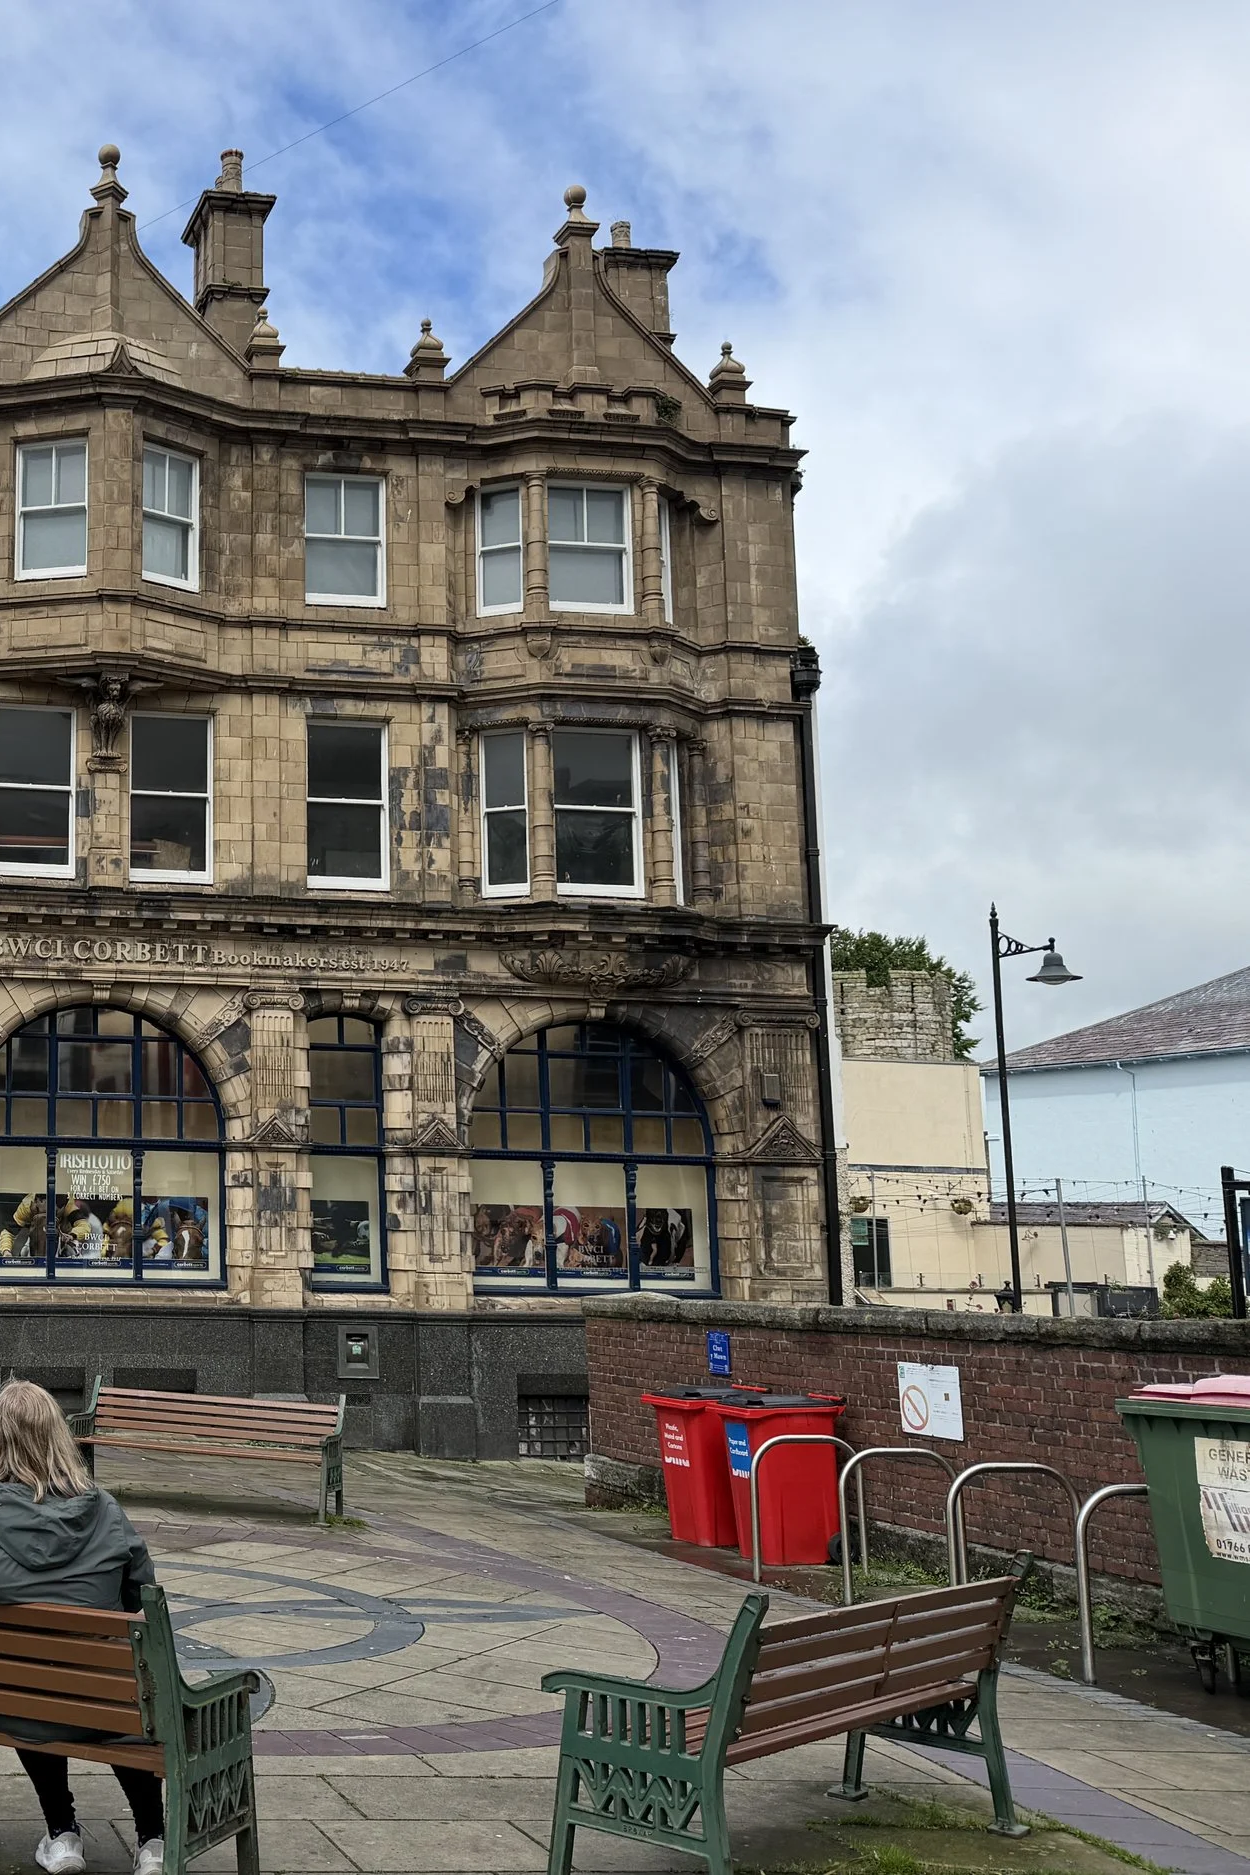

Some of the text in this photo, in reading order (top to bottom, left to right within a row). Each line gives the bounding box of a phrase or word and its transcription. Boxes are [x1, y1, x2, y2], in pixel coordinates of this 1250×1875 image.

[74, 939, 208, 963] CORBETT
[212, 950, 338, 968] Bookmakers
[60, 1154, 131, 1170] IRISH LOTTO
[71, 1174, 111, 1186] WIN £750
[70, 1185, 81, 1193] FOR
[73, 1191, 96, 1200] CORRECT
[99, 1193, 123, 1201] NUMBERS
[728, 1437, 747, 1447] Paper and
[729, 1446, 749, 1457] Cardboard
[1216, 1538, 1245, 1553] 01766
